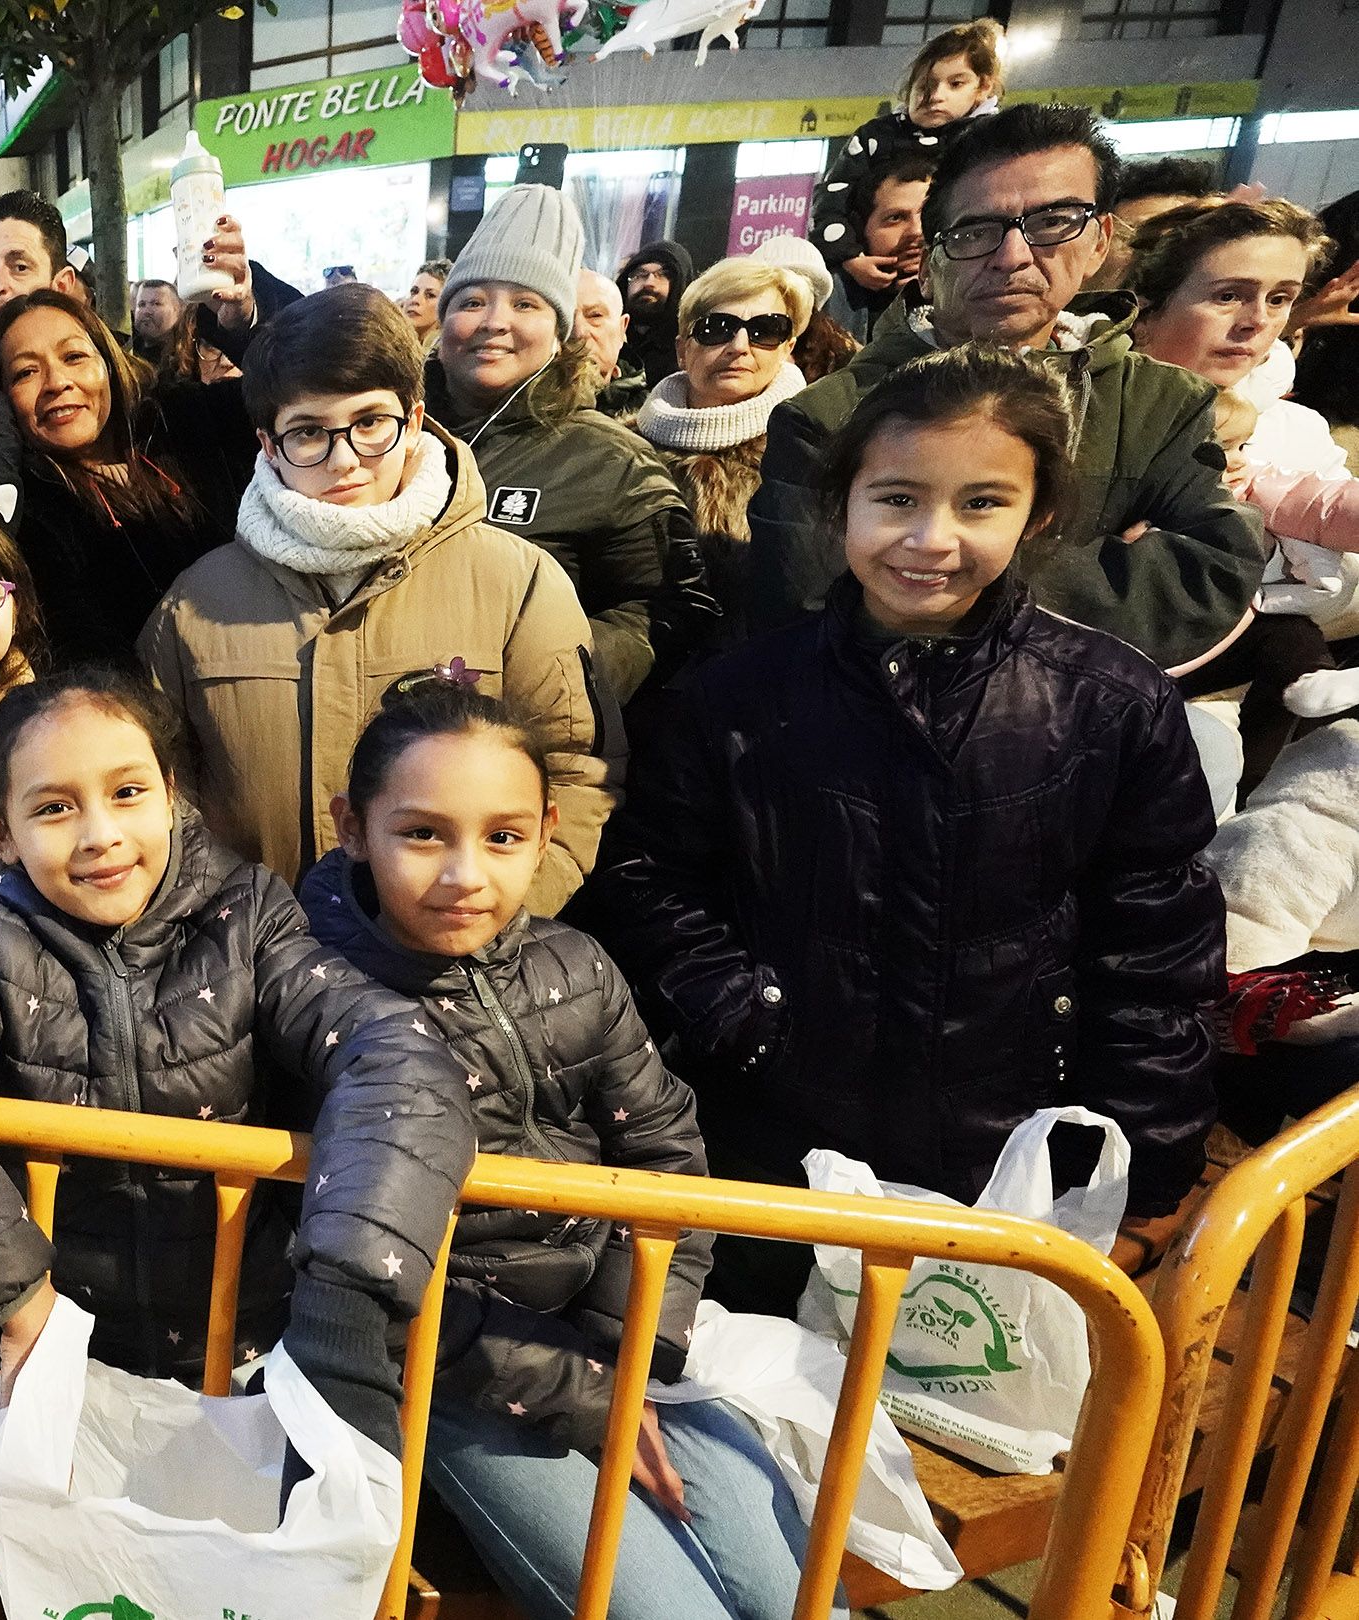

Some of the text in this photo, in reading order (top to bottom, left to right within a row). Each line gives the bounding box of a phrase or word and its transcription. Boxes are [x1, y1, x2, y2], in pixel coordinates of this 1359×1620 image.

[214, 75, 426, 135] PONTE BELLA
[592, 109, 676, 144] BELLA
[685, 105, 775, 134] HOGAR
[261, 127, 375, 174] HOGAR
[736, 194, 807, 218] Parking
[938, 1264, 1022, 1343] REUTILIZA
[906, 1323, 958, 1351] RECICLADA
[989, 1438, 1033, 1457] RECICLADO
